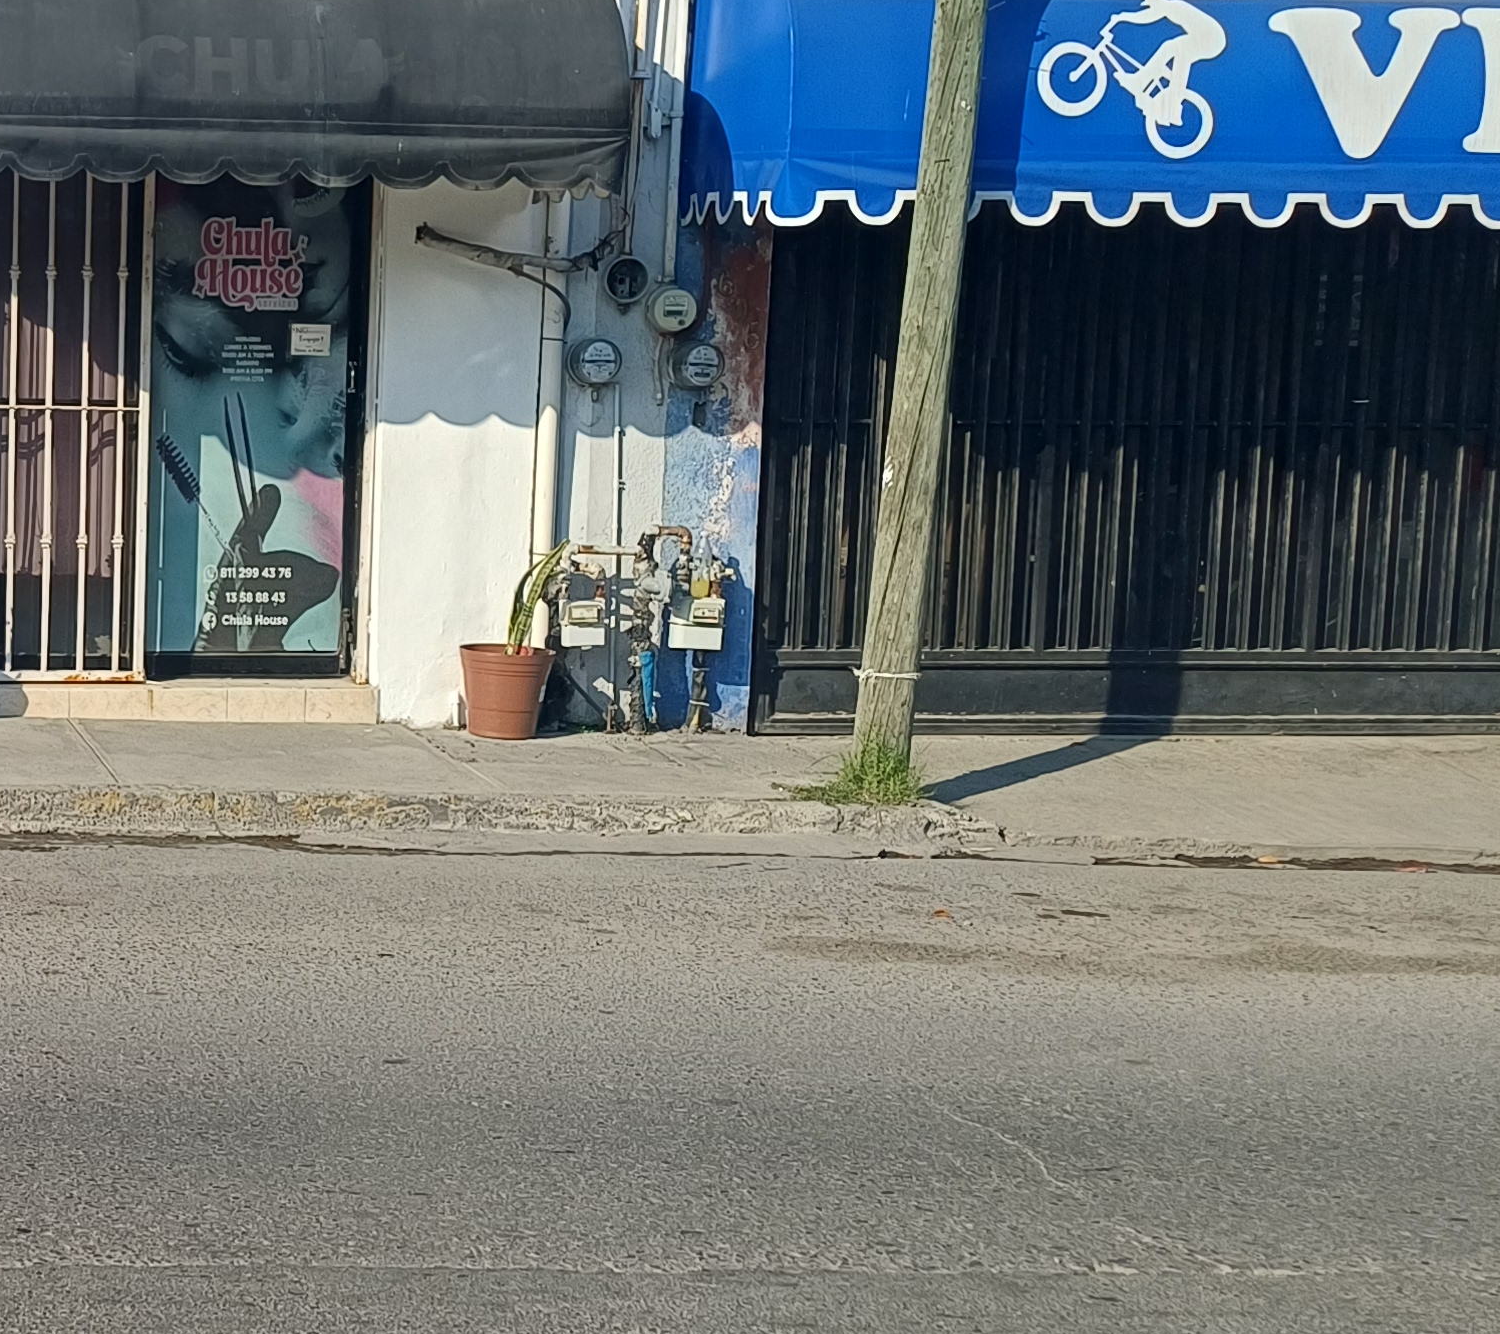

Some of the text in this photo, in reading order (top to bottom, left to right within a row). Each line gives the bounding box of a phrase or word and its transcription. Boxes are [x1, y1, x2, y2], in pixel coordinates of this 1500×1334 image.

[202, 218, 291, 268] Chula
[196, 257, 302, 309] House
[238, 567, 260, 579] 299
[261, 567, 276, 579] 43
[278, 567, 292, 579] 76
[225, 591, 238, 603] 13
[271, 591, 286, 603] 43
[221, 614, 289, 626] Chula House
